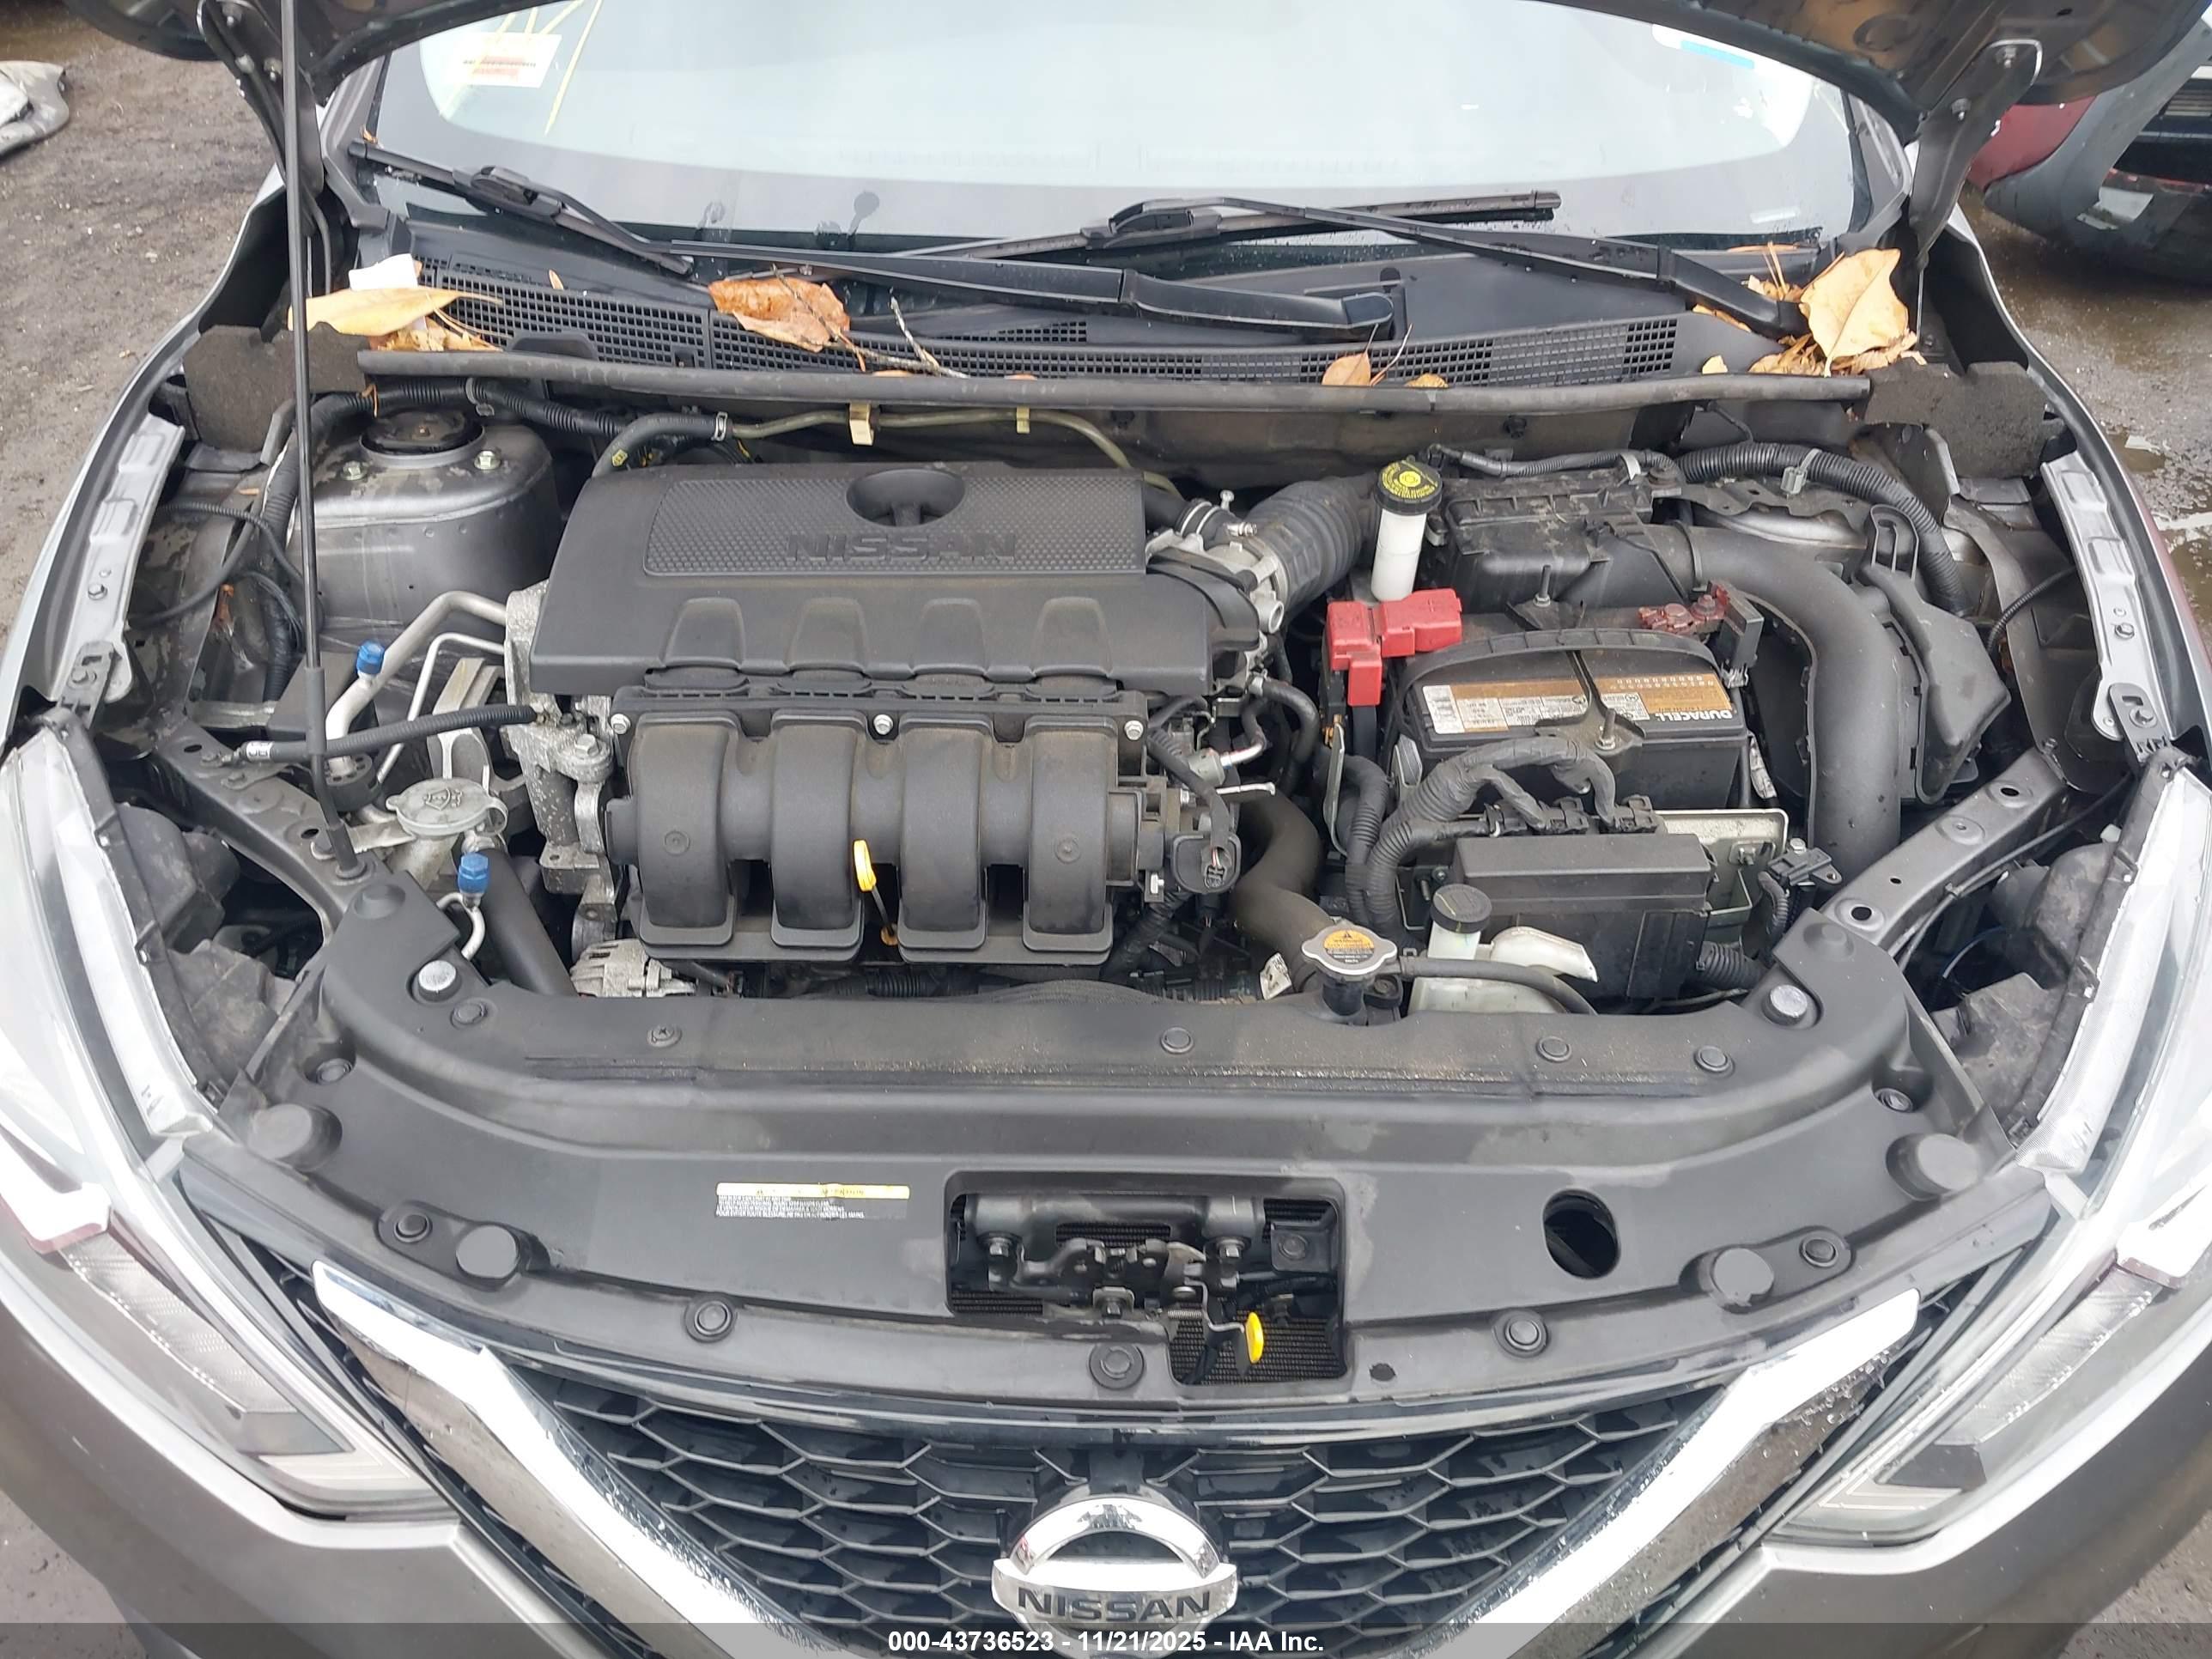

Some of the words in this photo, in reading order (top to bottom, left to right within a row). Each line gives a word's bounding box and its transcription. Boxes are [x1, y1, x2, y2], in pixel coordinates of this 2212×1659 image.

[787, 533, 1016, 562] NISSAN
[1655, 709, 1733, 722] DURACELL
[1018, 1586, 1210, 1622] NISSAN
